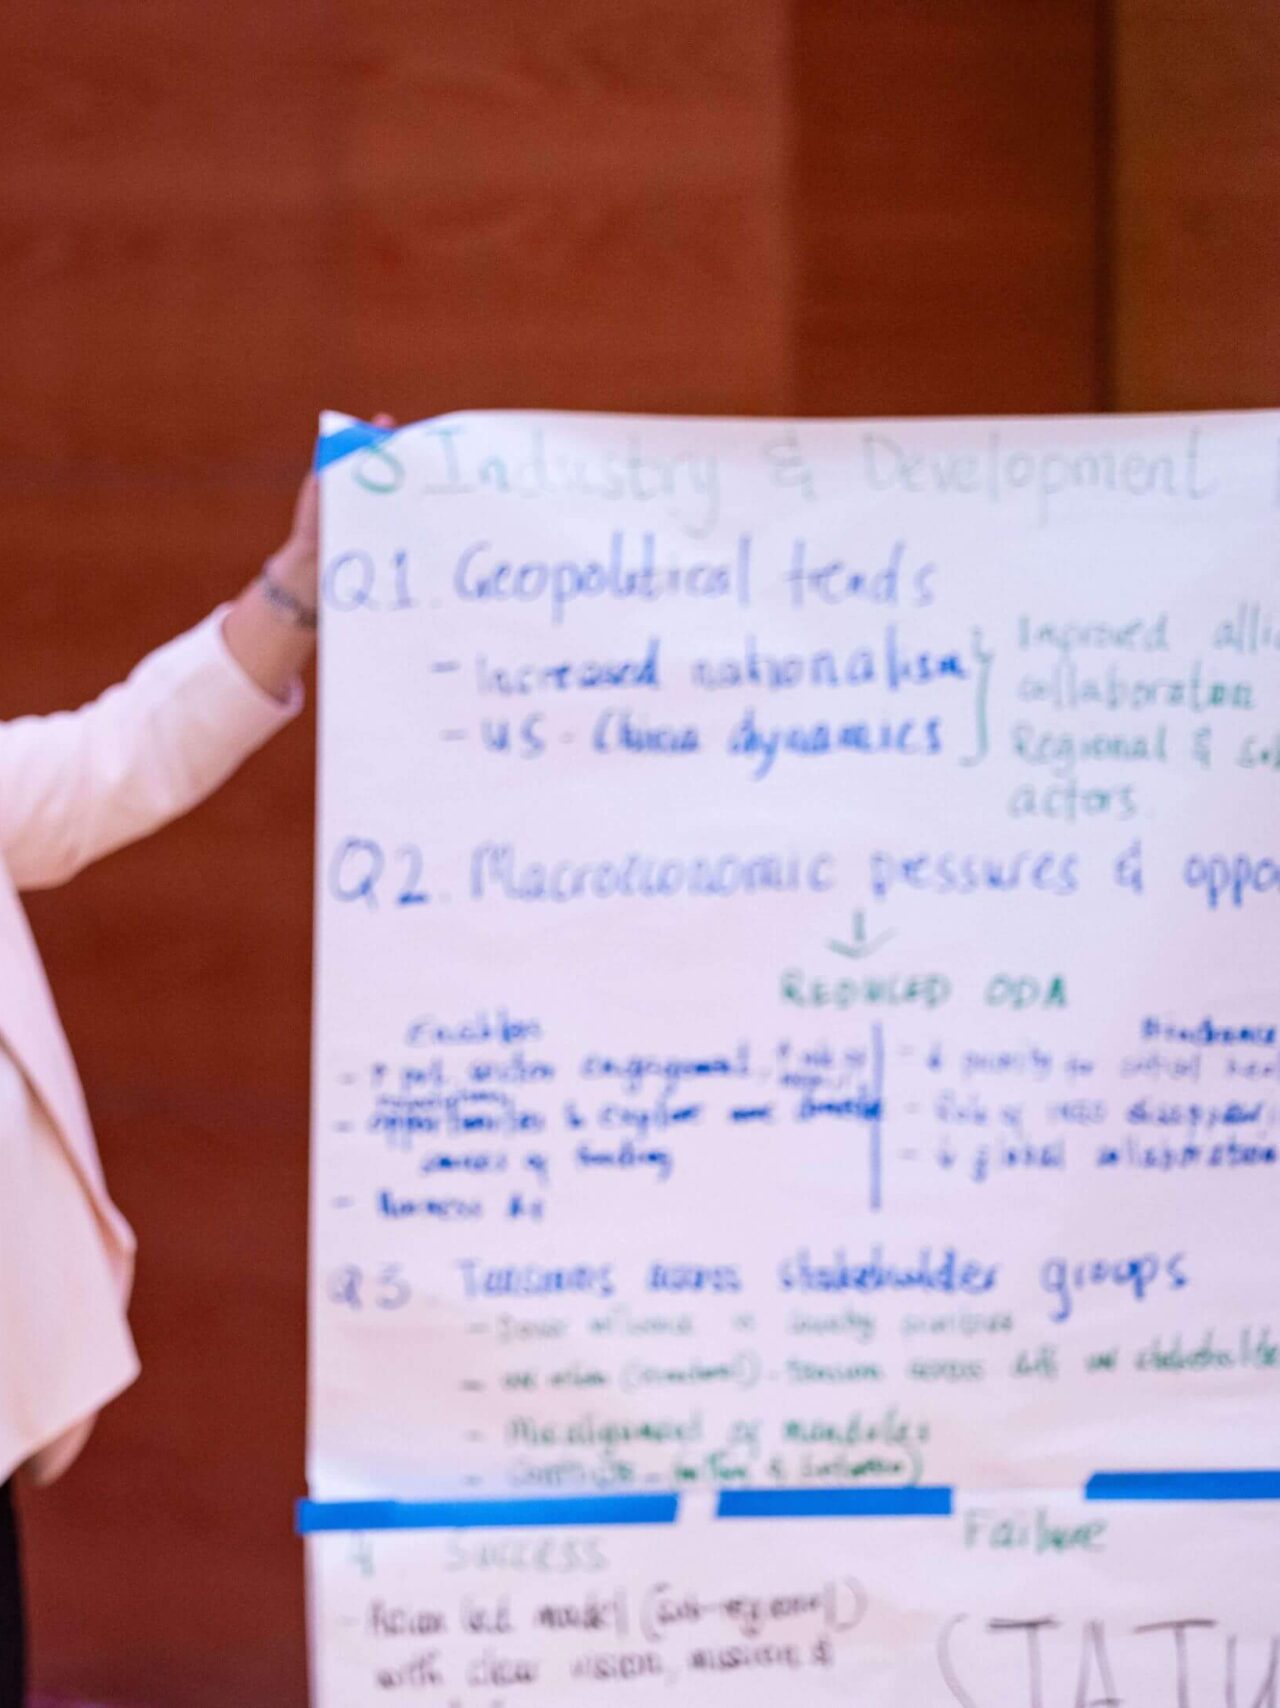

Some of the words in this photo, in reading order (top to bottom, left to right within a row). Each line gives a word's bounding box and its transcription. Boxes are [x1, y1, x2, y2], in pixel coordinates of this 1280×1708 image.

[420, 426, 723, 540] Industry
[861, 424, 1214, 530] Development
[452, 528, 750, 628] Geopolitical
[1040, 1251, 1192, 1322] groups
